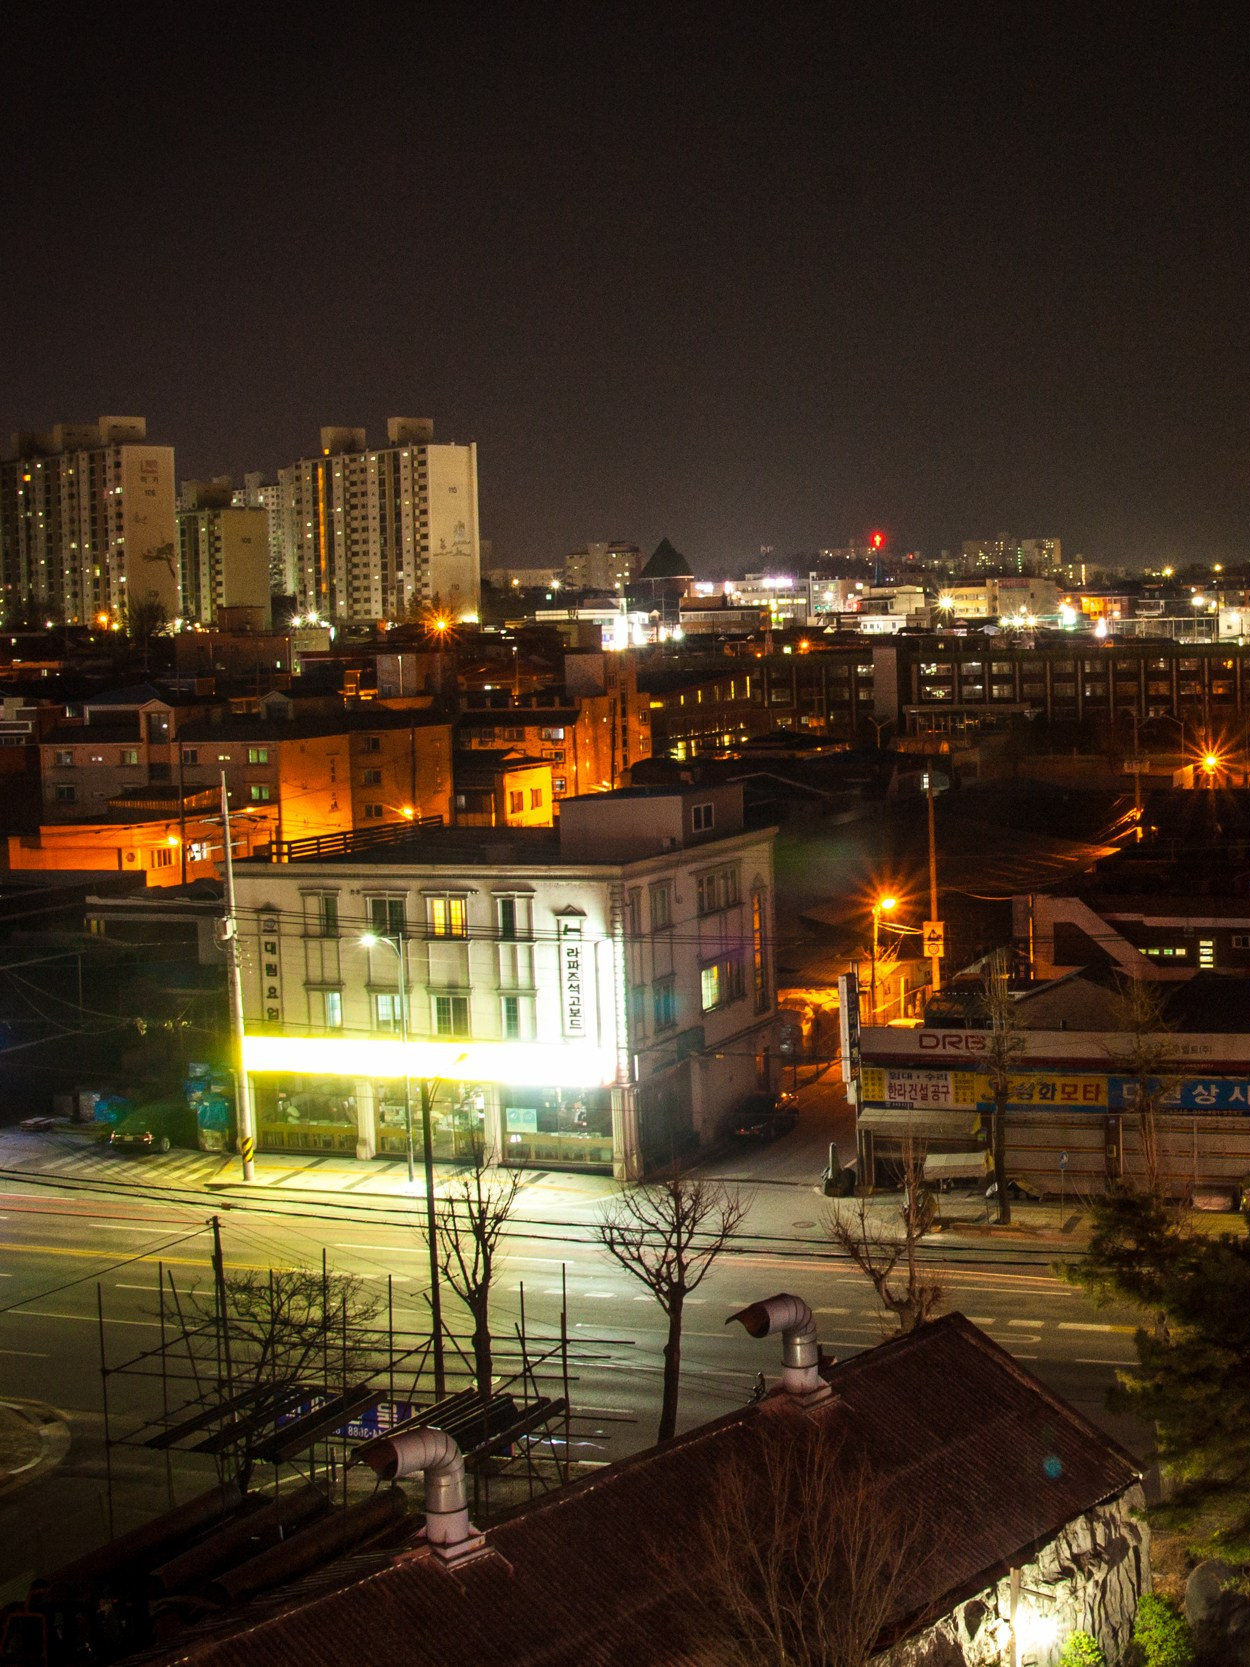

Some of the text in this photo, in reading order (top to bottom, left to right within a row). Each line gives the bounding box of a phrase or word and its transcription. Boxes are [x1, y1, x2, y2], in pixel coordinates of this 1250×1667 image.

[264, 941, 280, 1020] 대림요업
[566, 947, 582, 1029] 라파즈석고보드
[918, 1033, 987, 1051] DRB
